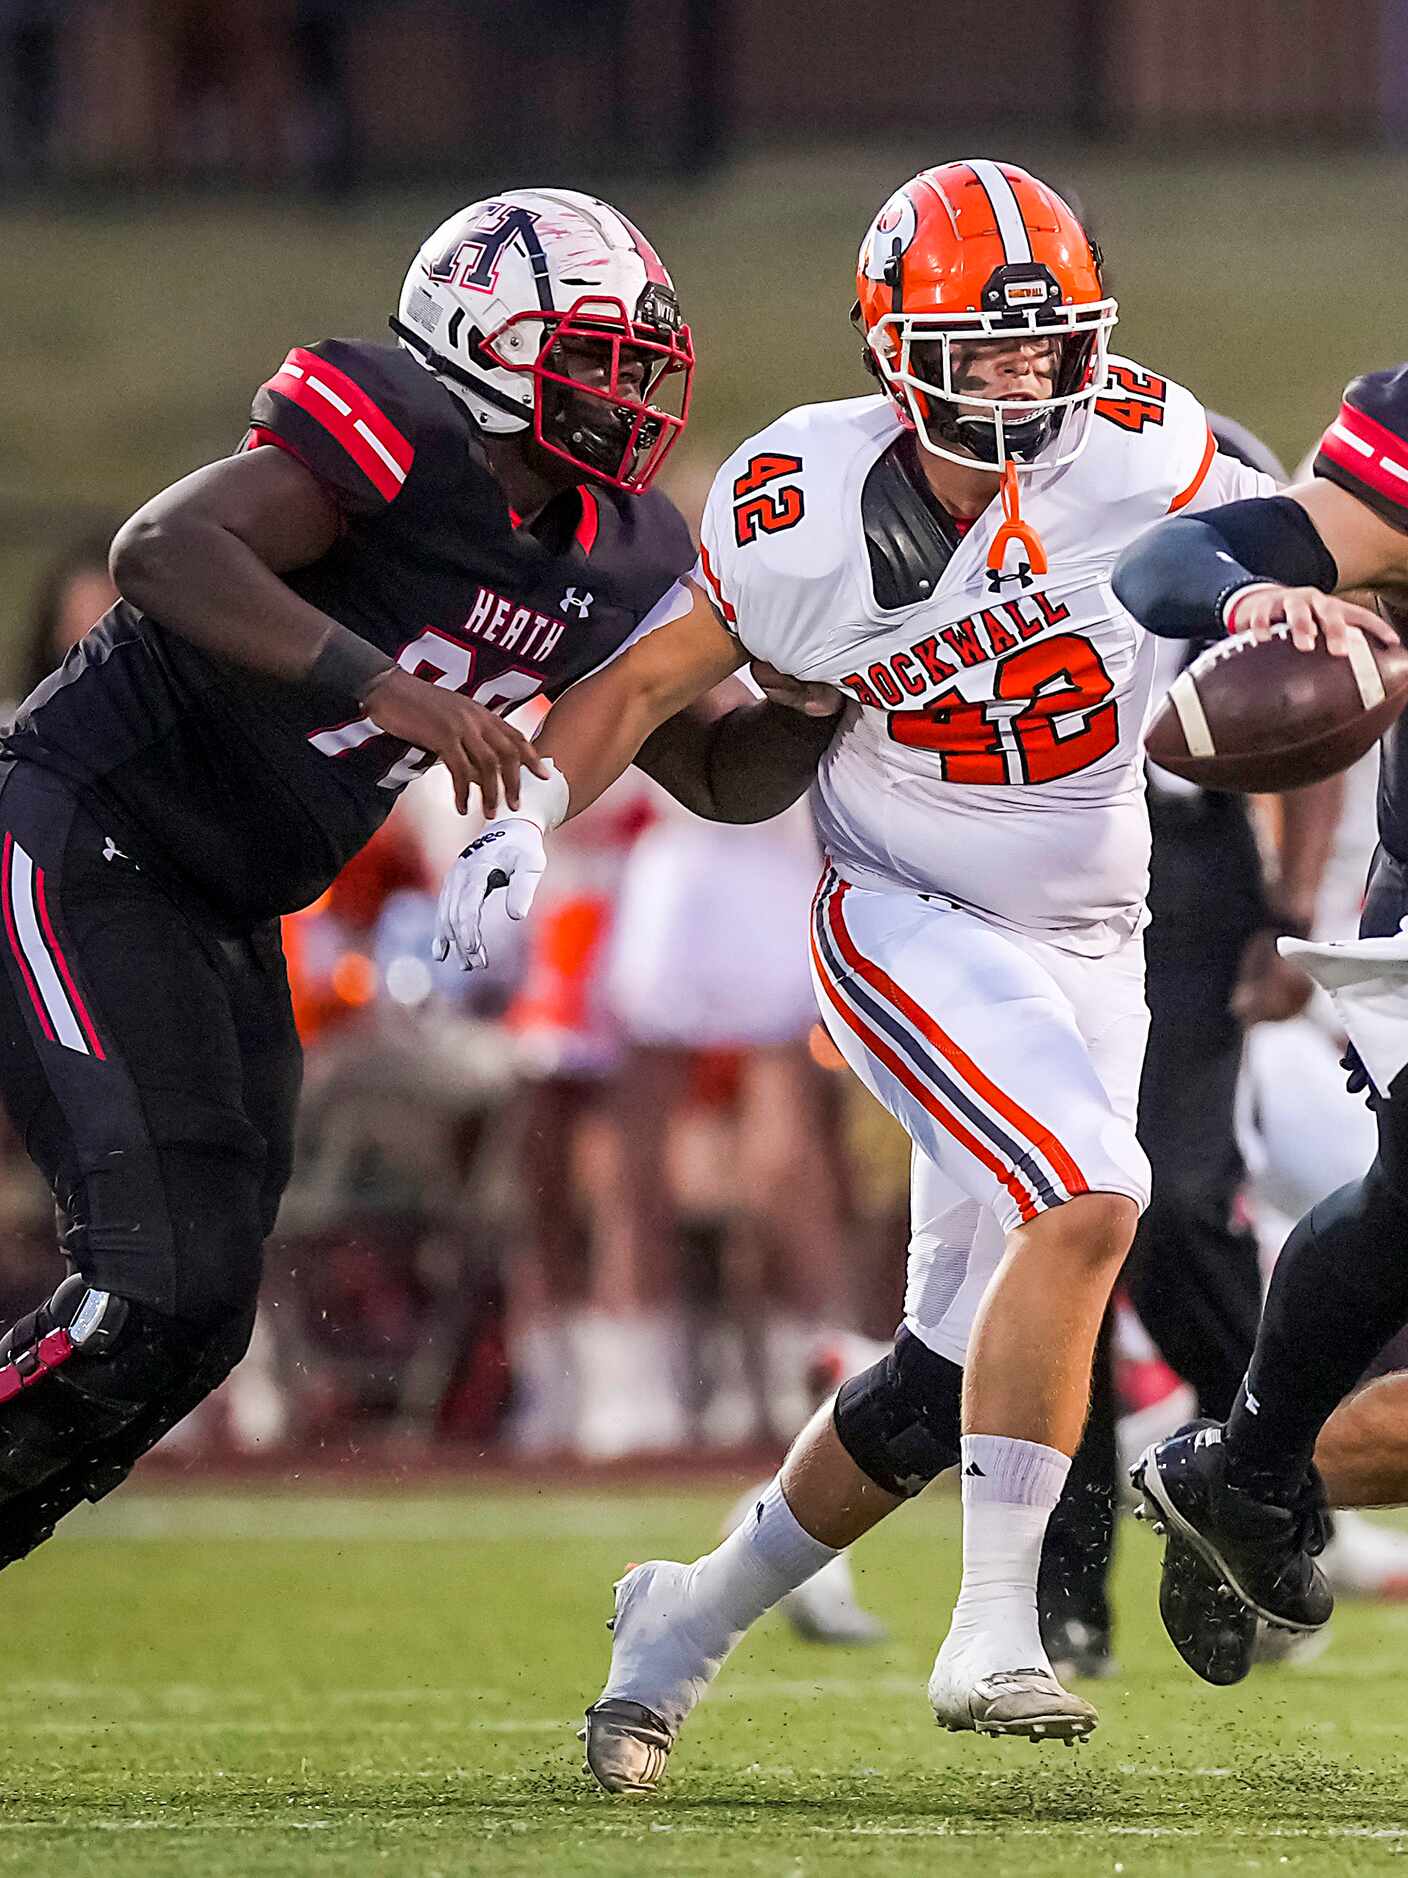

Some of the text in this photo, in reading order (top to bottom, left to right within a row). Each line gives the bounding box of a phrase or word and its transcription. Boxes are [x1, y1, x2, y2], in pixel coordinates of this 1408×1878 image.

[428, 202, 542, 295] H
[1095, 362, 1168, 434] 42
[733, 452, 805, 548] 42
[463, 584, 568, 663] HEATH
[839, 591, 1070, 712] ROCKWALL
[887, 632, 1119, 785] 42
